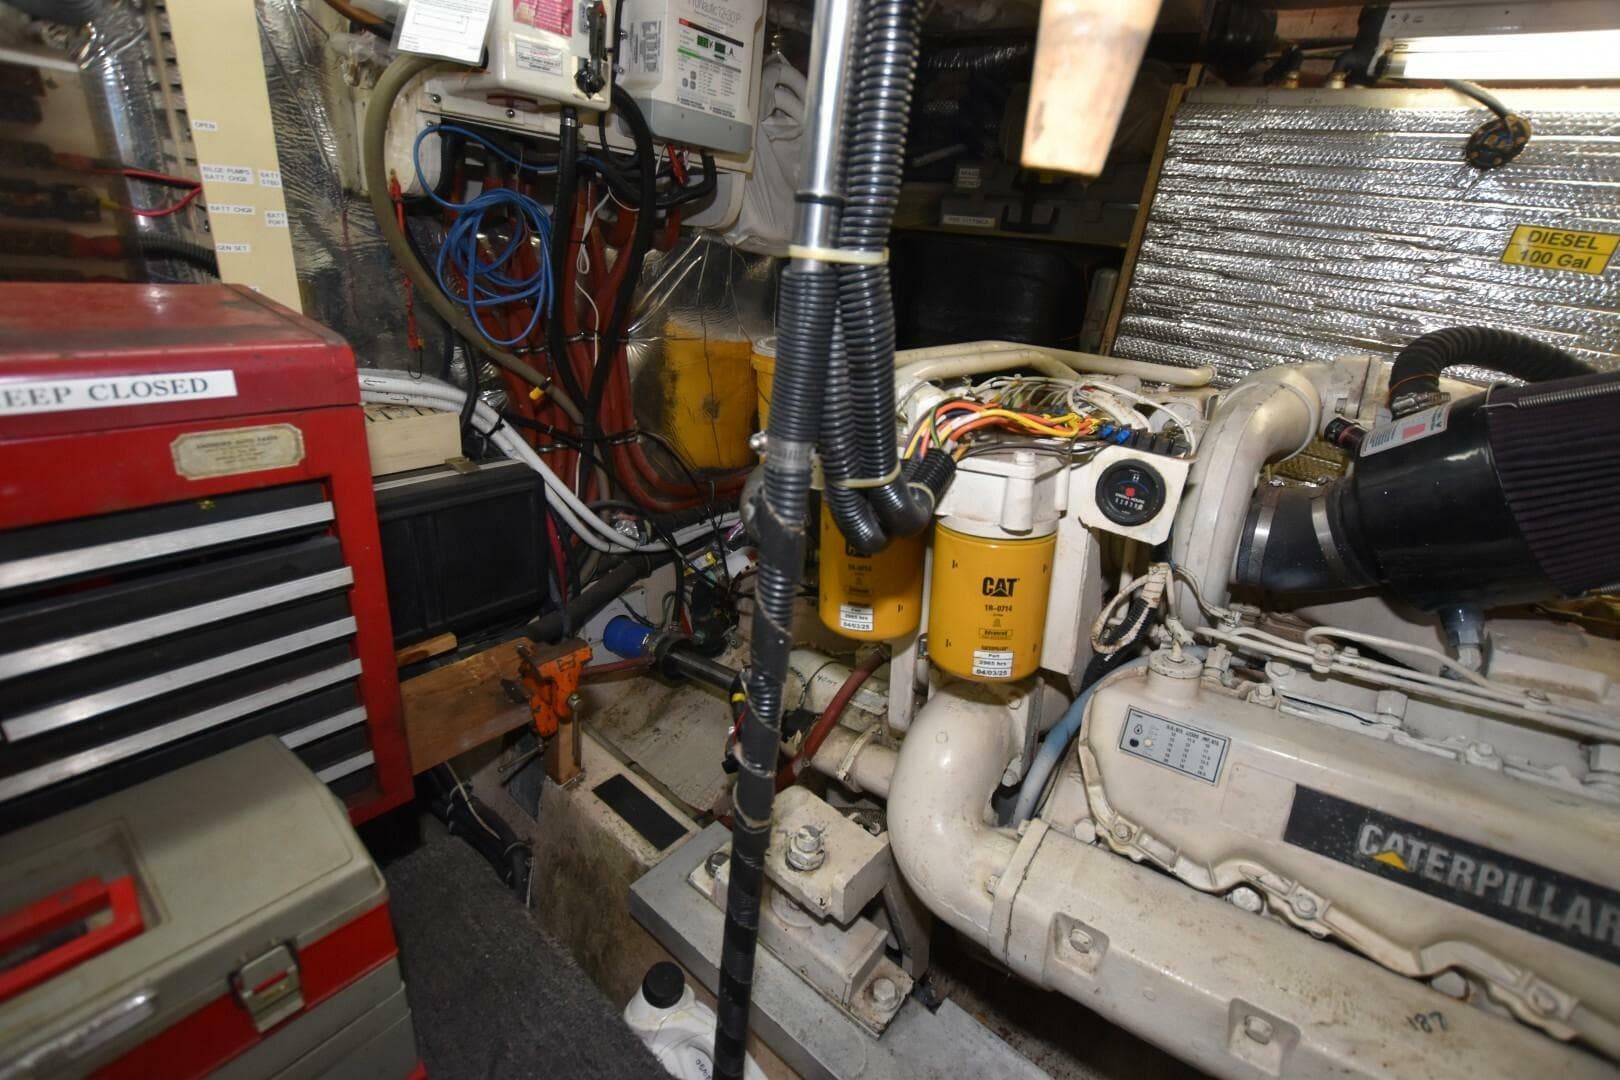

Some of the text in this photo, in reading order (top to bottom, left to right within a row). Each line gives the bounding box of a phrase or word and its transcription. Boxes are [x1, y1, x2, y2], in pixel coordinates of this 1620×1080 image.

[203, 165, 250, 175] BILGE PUMPS
[1527, 229, 1598, 250] DIESEL
[1520, 249, 1592, 269] 100 Gal
[0, 377, 209, 408] EEP CLOSED
[982, 577, 1018, 597] CAT
[1358, 823, 1620, 946] CATERPILLAR
